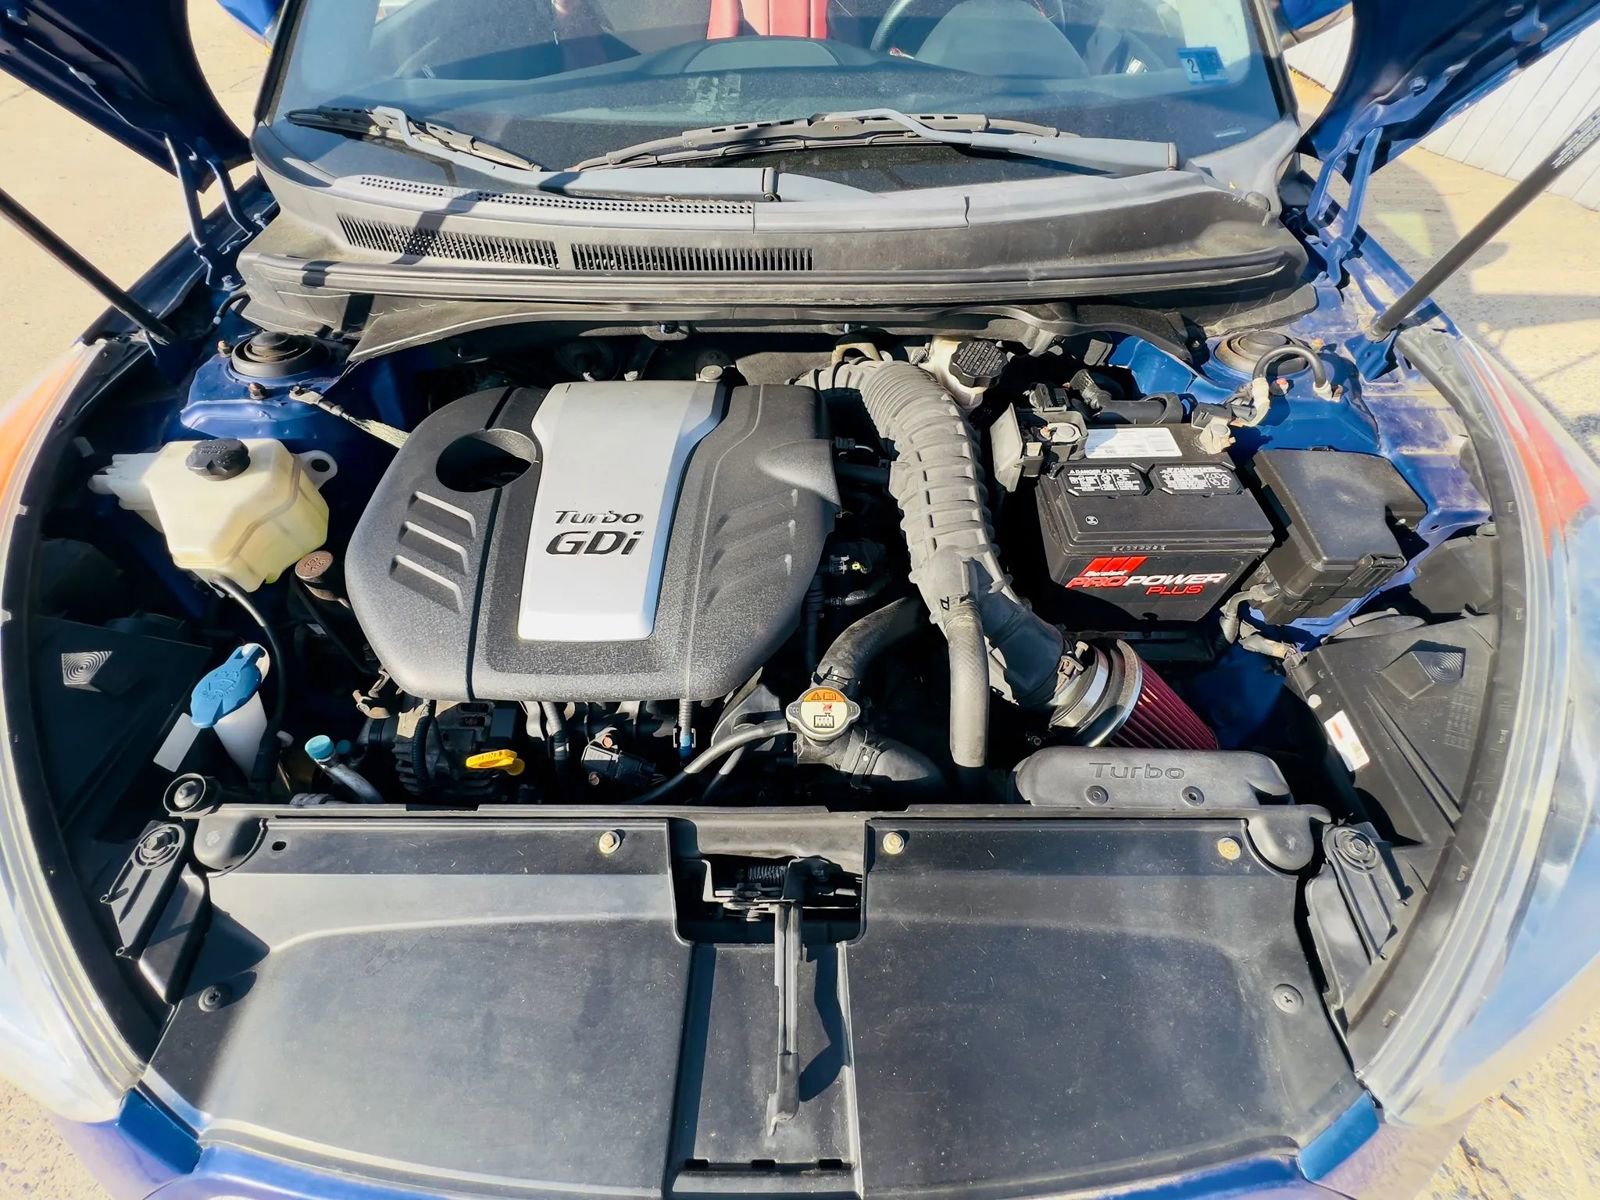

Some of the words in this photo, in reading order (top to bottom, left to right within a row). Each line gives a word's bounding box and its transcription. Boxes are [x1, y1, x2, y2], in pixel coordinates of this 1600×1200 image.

[1187, 59, 1198, 74] 2
[555, 510, 643, 525] Turbo
[545, 530, 645, 555] GDi
[1145, 584, 1204, 596] PLUS
[1088, 762, 1185, 780] Turbo
